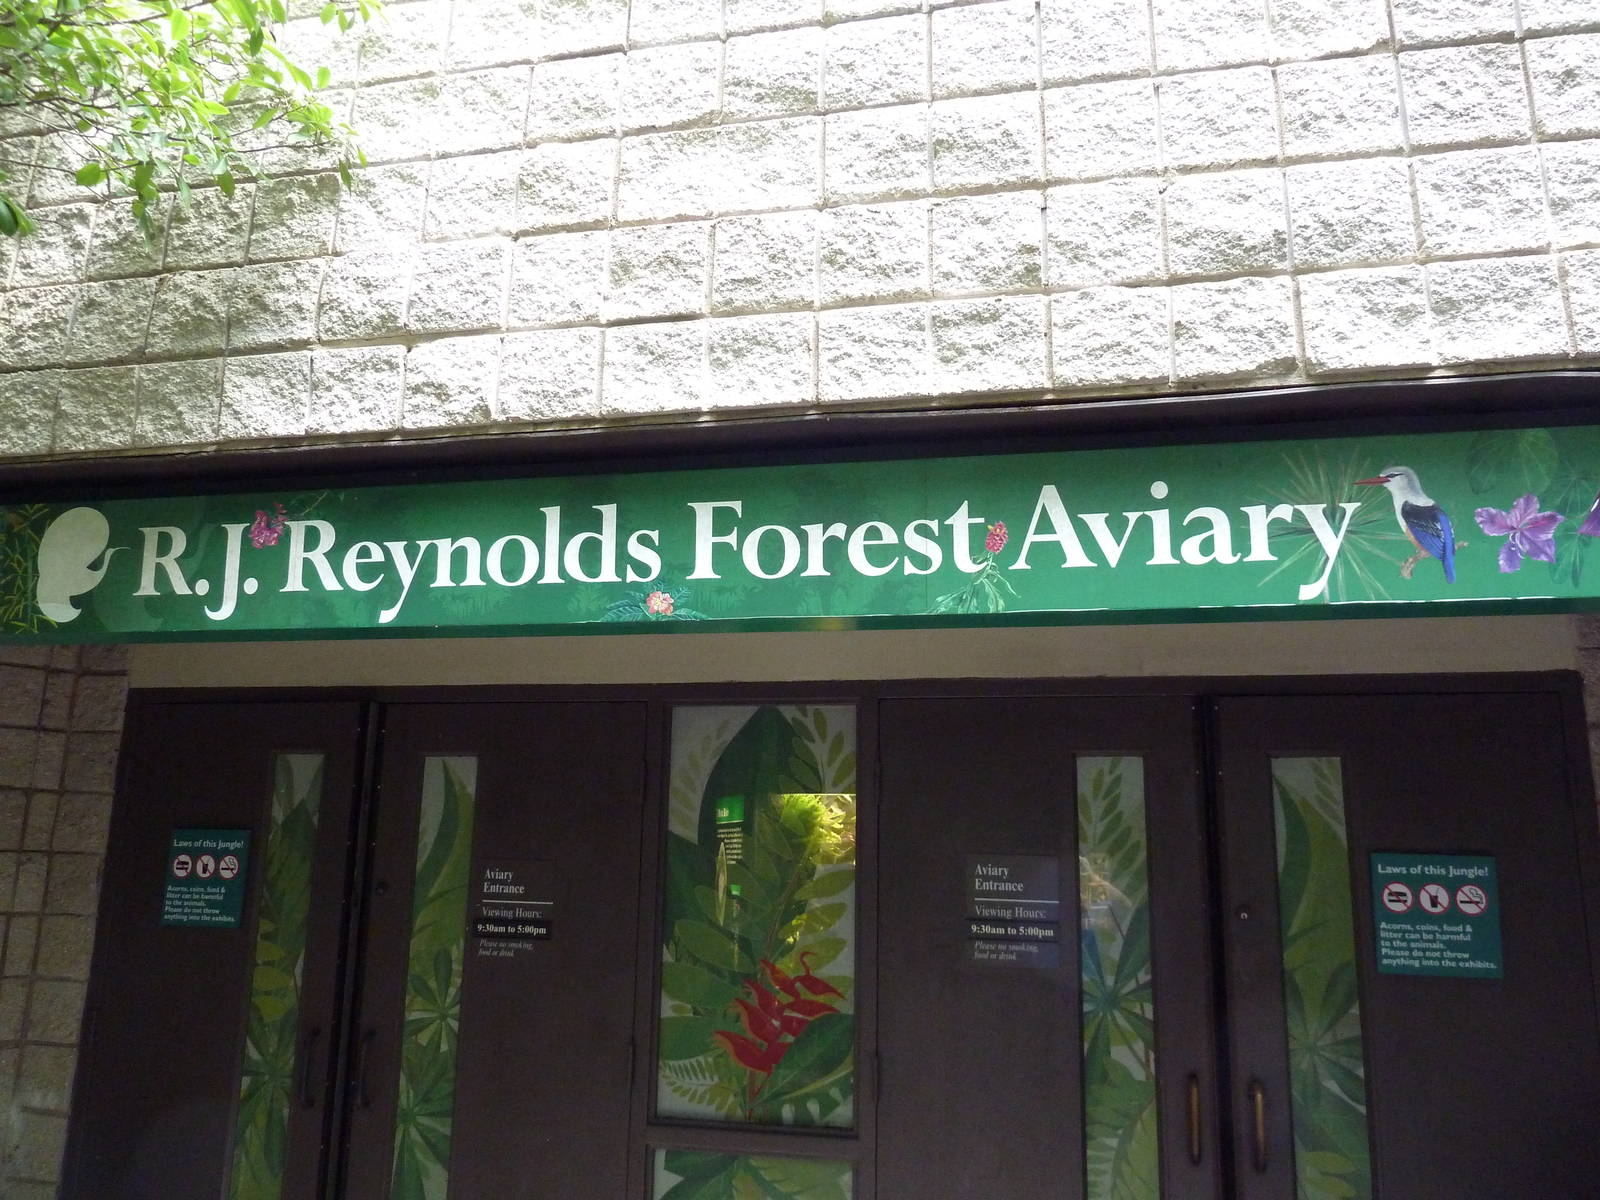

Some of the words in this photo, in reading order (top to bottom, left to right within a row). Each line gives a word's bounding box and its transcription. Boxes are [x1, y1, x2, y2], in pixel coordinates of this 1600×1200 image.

[133, 523, 258, 621] R.J.
[279, 504, 661, 624] Reynolds
[687, 500, 987, 583] Forest
[1008, 481, 1362, 601] Aviary
[485, 868, 513, 882] Aviary
[975, 864, 1009, 879] Aviary
[1378, 864, 1407, 874] Laws
[1410, 865, 1422, 873] of
[1425, 865, 1446, 875] this
[1448, 866, 1488, 878] Jungle!
[483, 882, 525, 894] Entrance
[975, 878, 1024, 891] Entrance
[482, 907, 514, 919] Viewing
[975, 905, 1012, 919] Viewing
[478, 924, 505, 933] 9:30am
[508, 925, 515, 933] to
[517, 925, 546, 935] 5:00pm
[971, 924, 1005, 934] 9:30am
[1008, 926, 1016, 934] to
[1019, 927, 1054, 938] 5:00pm
[1380, 922, 1413, 931] Acorns,
[1416, 924, 1441, 932] coins,
[1443, 924, 1463, 932] food
[1380, 931, 1401, 939] litter
[1436, 932, 1471, 941] harmful
[1410, 941, 1446, 949] animals.
[1382, 948, 1409, 956] Please
[1382, 958, 1420, 967] anything
[1459, 960, 1497, 969] exhibits.
